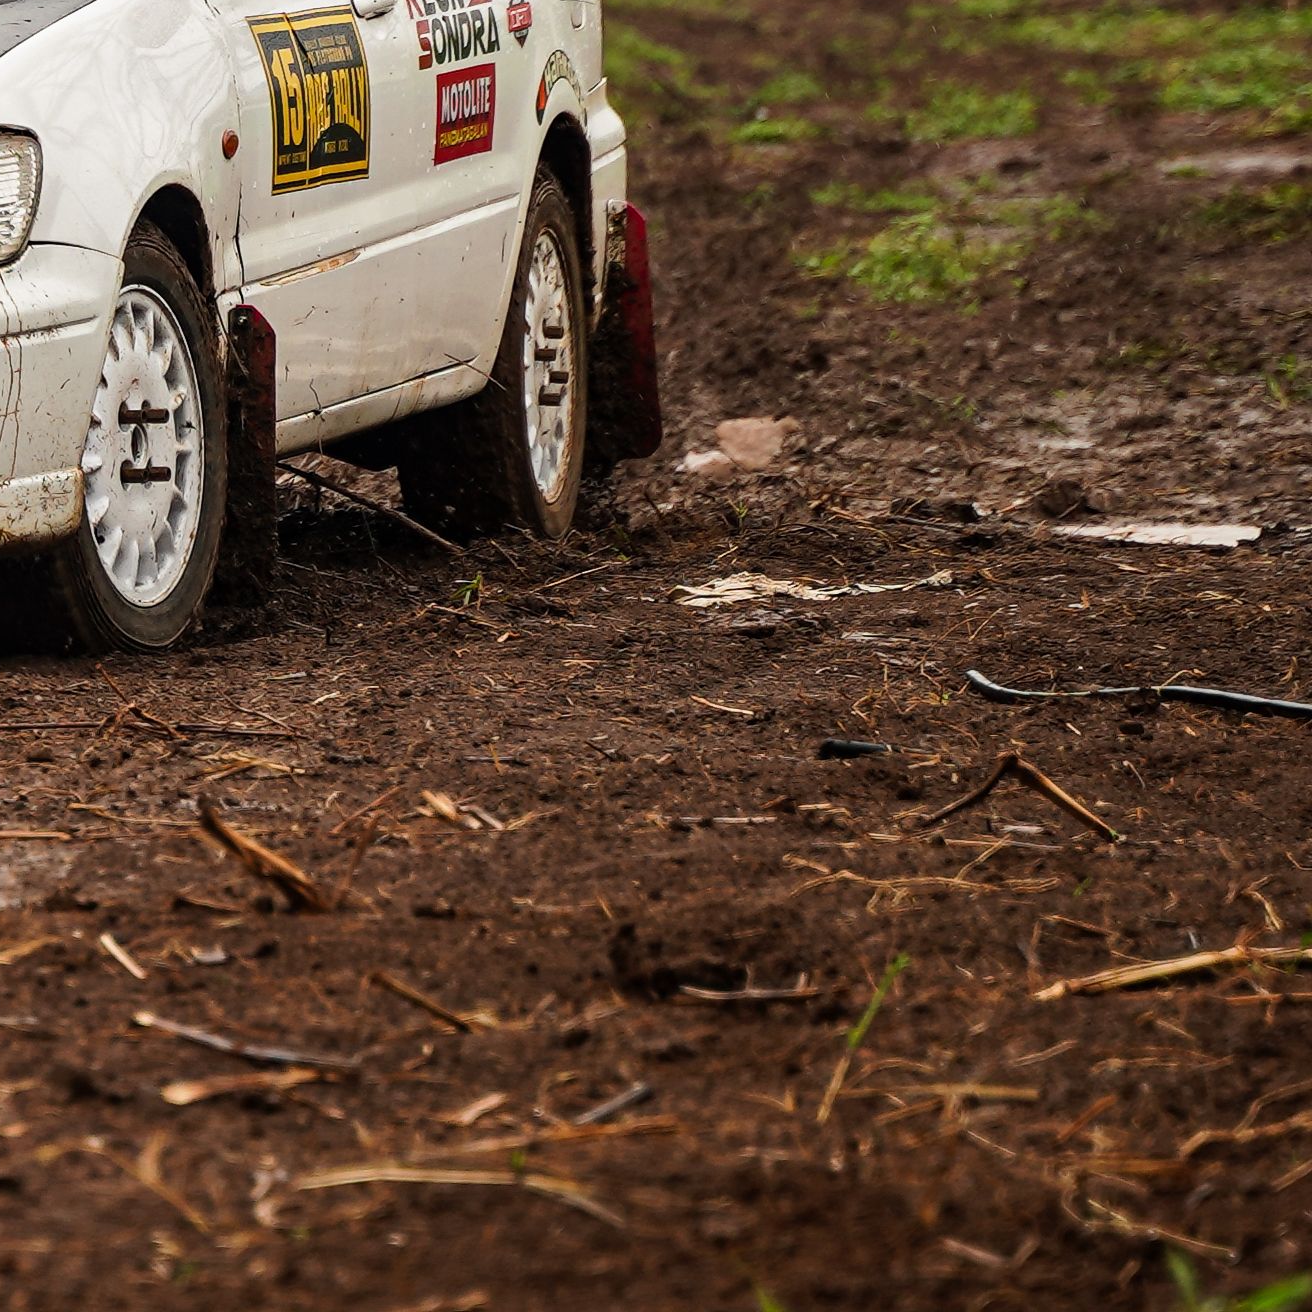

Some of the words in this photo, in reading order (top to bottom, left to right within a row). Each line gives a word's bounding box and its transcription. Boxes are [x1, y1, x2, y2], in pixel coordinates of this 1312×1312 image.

[416, 7, 501, 70] SONDRA
[271, 48, 304, 146] 15
[331, 67, 365, 140] RALLY
[440, 76, 491, 123] MOTOLITE
